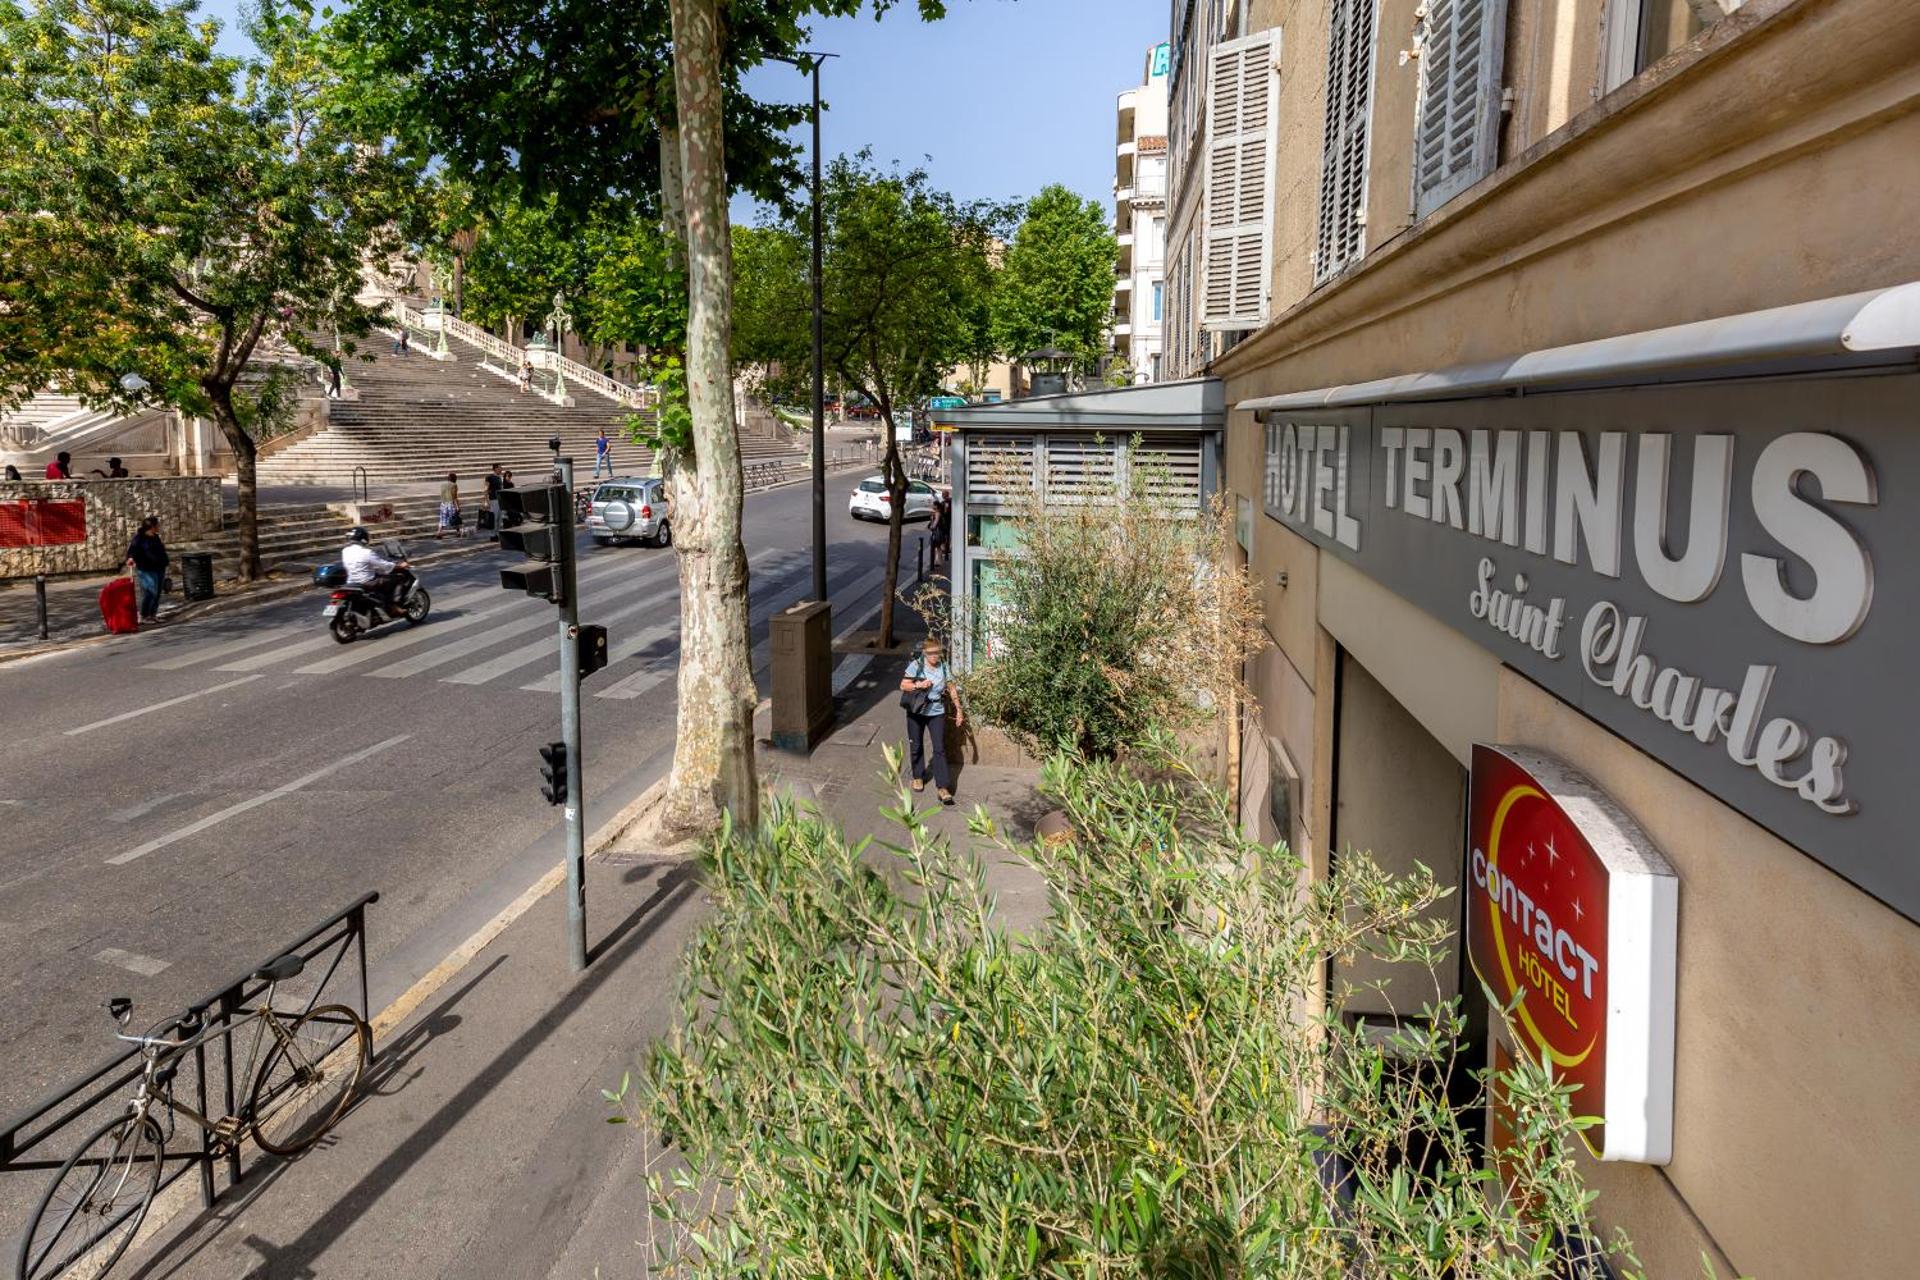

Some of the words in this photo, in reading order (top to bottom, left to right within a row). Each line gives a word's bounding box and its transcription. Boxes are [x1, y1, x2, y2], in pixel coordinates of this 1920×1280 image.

[1264, 424, 1361, 552] HOTEL
[1380, 427, 1878, 644] TERMINUS
[1469, 557, 1566, 660] Saint
[1580, 600, 1858, 816] Charles
[1518, 944, 1578, 1029] HÔTEL
